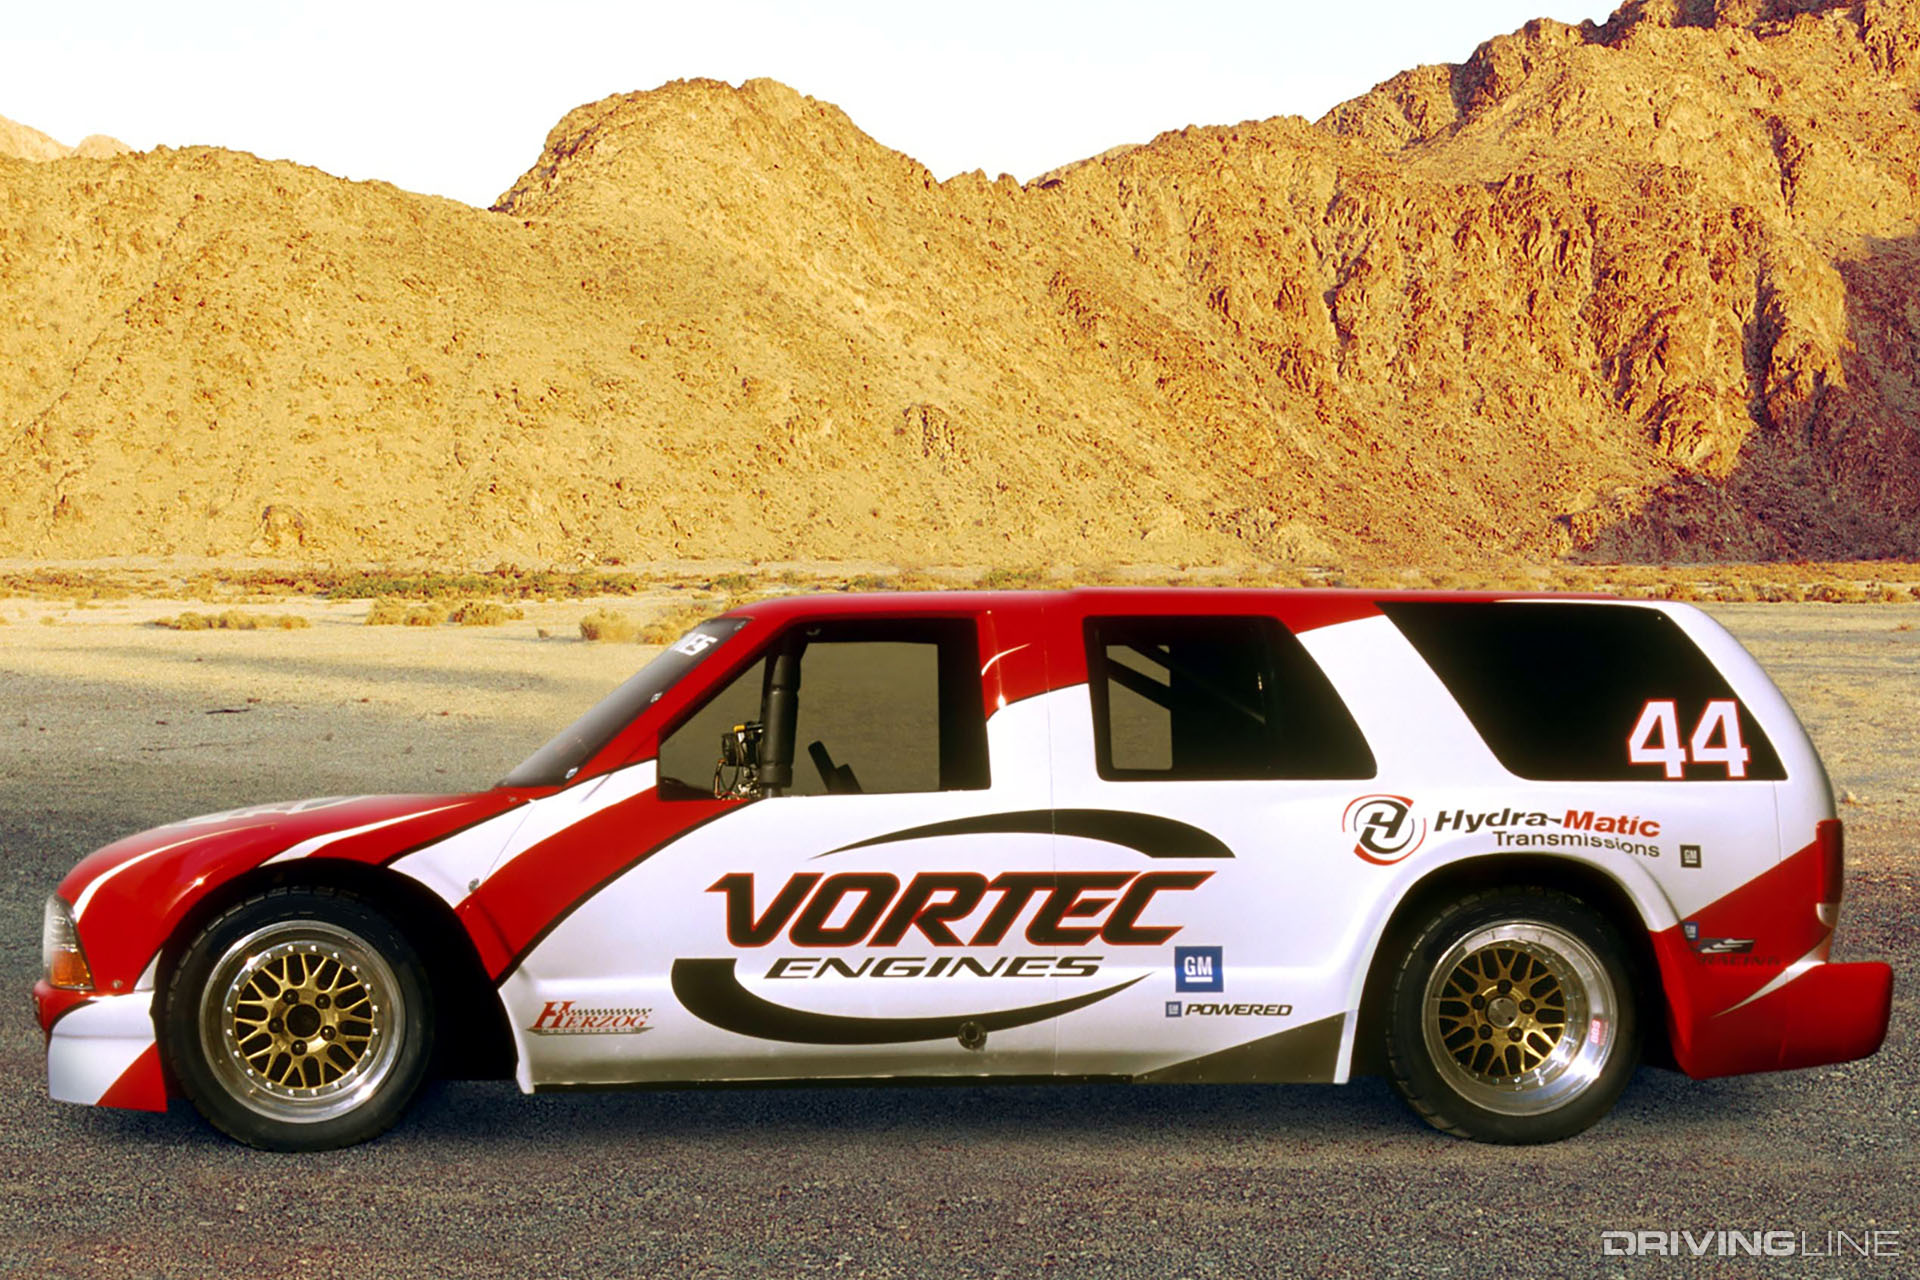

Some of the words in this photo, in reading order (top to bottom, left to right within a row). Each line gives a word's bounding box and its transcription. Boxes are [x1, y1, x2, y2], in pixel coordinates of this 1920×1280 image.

[1627, 699, 1750, 780] 44
[1434, 808, 1661, 838] Hydra-Matic
[1492, 831, 1660, 857] Transmissions
[704, 871, 1217, 948] VORTEC
[763, 956, 1104, 979] ENGINES
[1184, 956, 1213, 976] GM
[533, 1001, 649, 1029] HERZOG
[1185, 1003, 1293, 1016] POWERED
